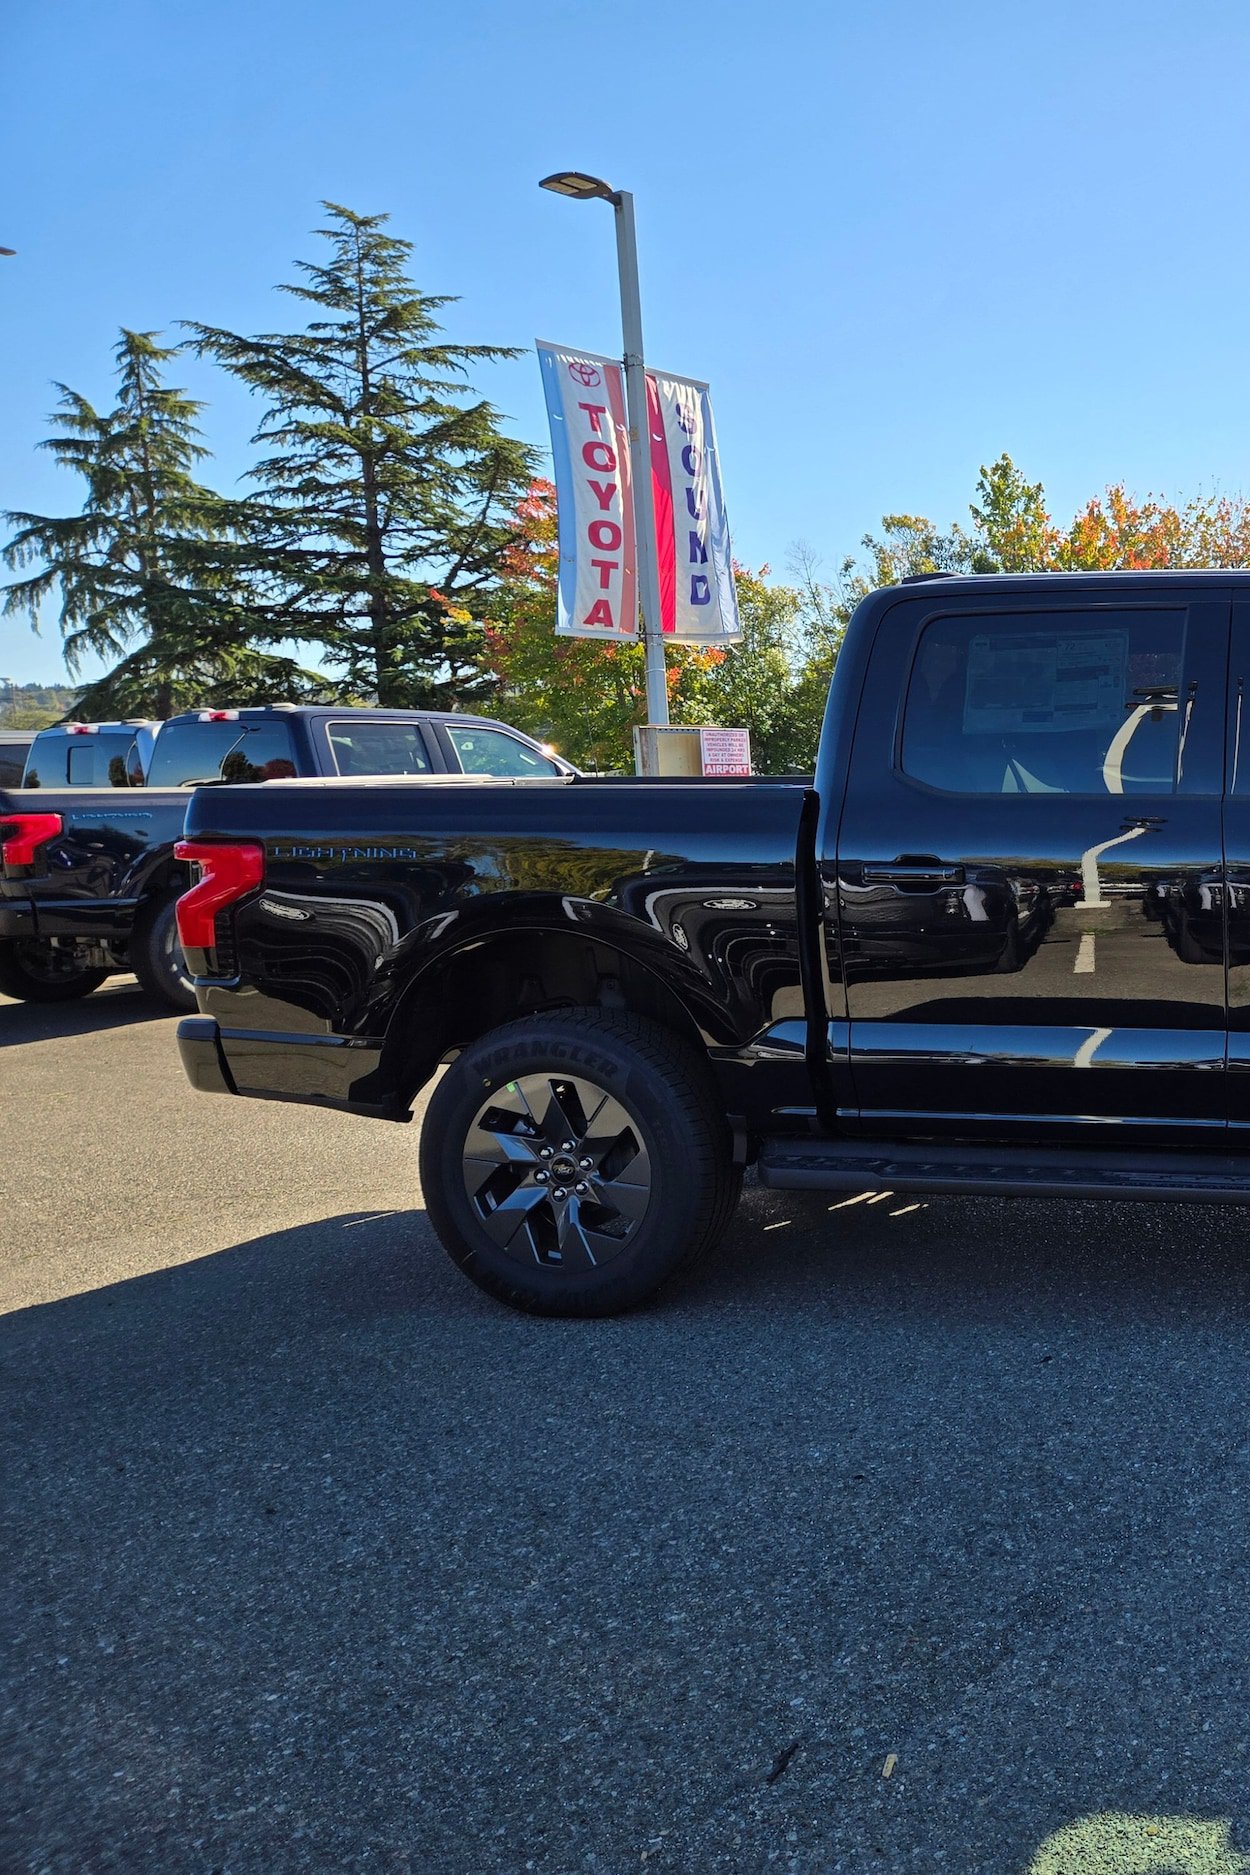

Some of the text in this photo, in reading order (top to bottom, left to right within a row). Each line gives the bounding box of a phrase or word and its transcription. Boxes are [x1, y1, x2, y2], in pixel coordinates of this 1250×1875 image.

[578, 402, 622, 627] TOYOTA
[675, 402, 711, 606] SOUND
[705, 764, 749, 774] AIRPORT
[274, 847, 417, 863] LIGHTNING
[473, 1040, 617, 1077] WRANGLER
